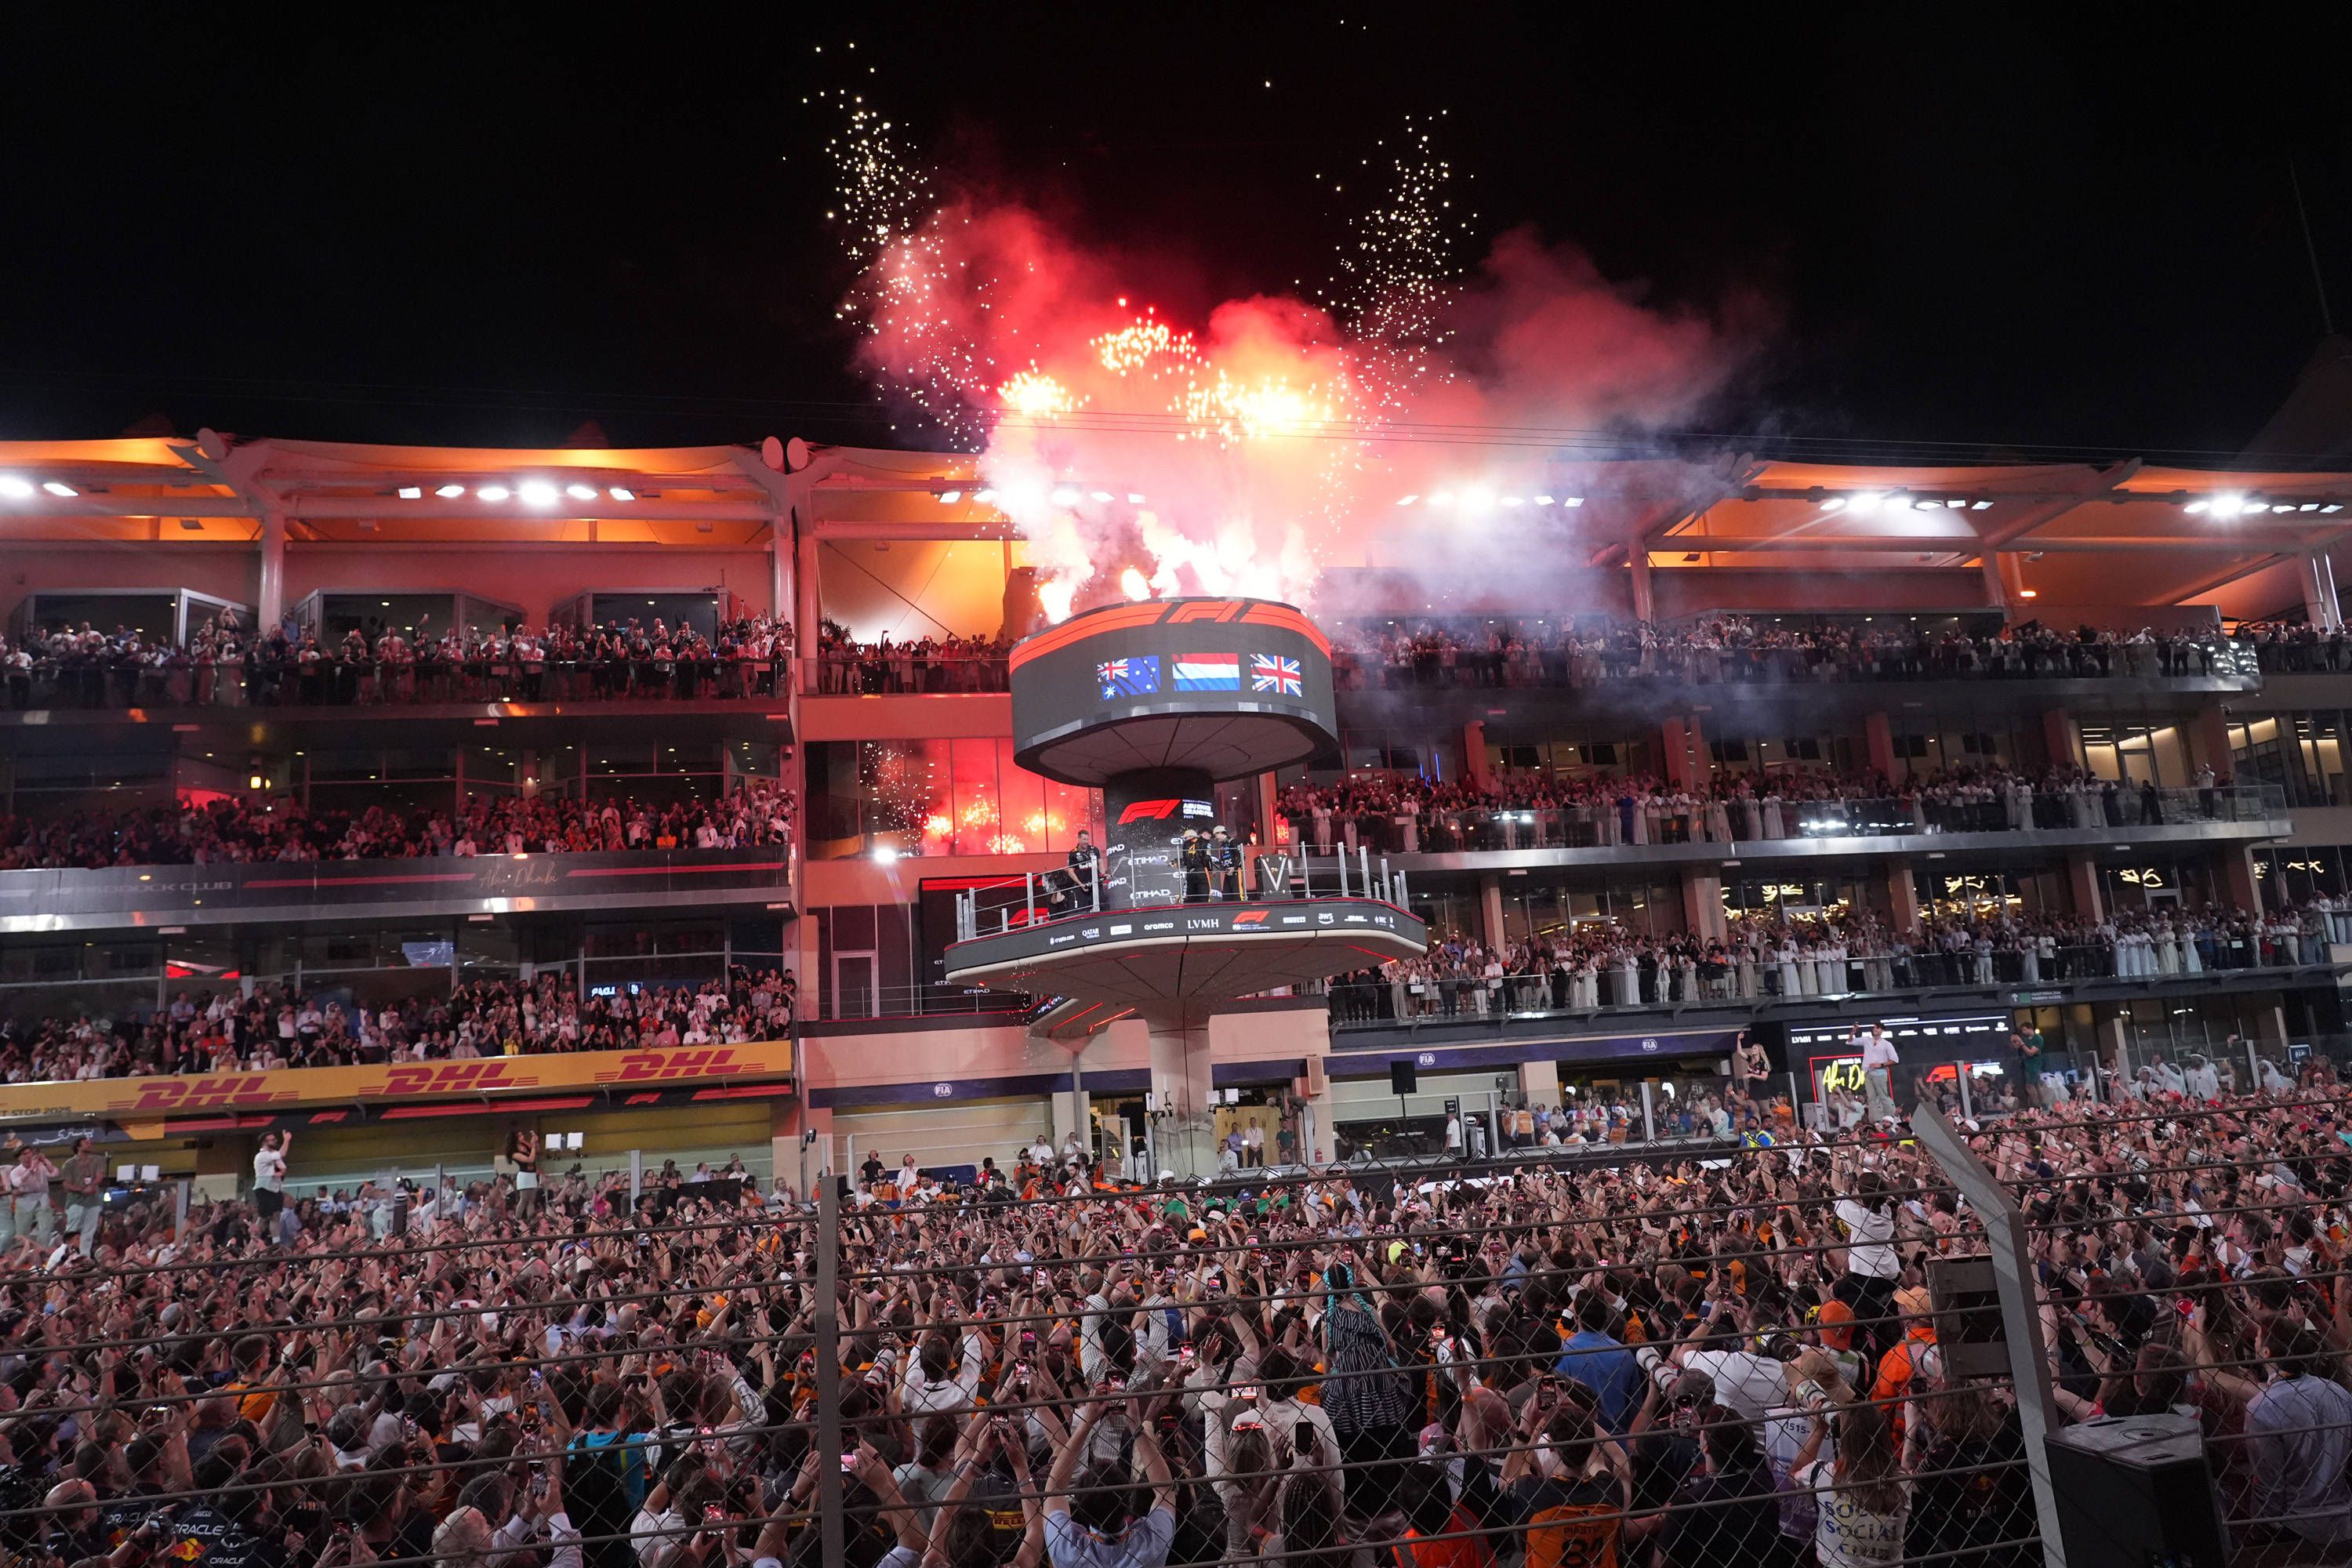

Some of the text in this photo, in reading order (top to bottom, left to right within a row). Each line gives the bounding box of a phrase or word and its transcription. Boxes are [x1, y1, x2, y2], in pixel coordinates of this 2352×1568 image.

[1167, 602, 1245, 622] F1
[1117, 799, 1181, 825] F1
[1189, 844, 1196, 855] 4
[180, 881, 233, 891] CLUB
[1130, 889, 1171, 901] ETIHAD
[1232, 910, 1270, 923] F1
[1144, 922, 1174, 931] aramco
[1187, 919, 1219, 929] LVMH
[1082, 927, 1099, 937] QATAR
[1642, 1040, 1657, 1050] FIA
[1419, 1054, 1435, 1064] FIA
[618, 1050, 742, 1080] DHL
[384, 1063, 514, 1094] DHL
[135, 1076, 274, 1109] DHL
[935, 1084, 952, 1096] FIA
[12, 1107, 41, 1116] STOP
[1561, 1536, 1603, 1567] 81
[209, 1556, 245, 1565] ORACLE
